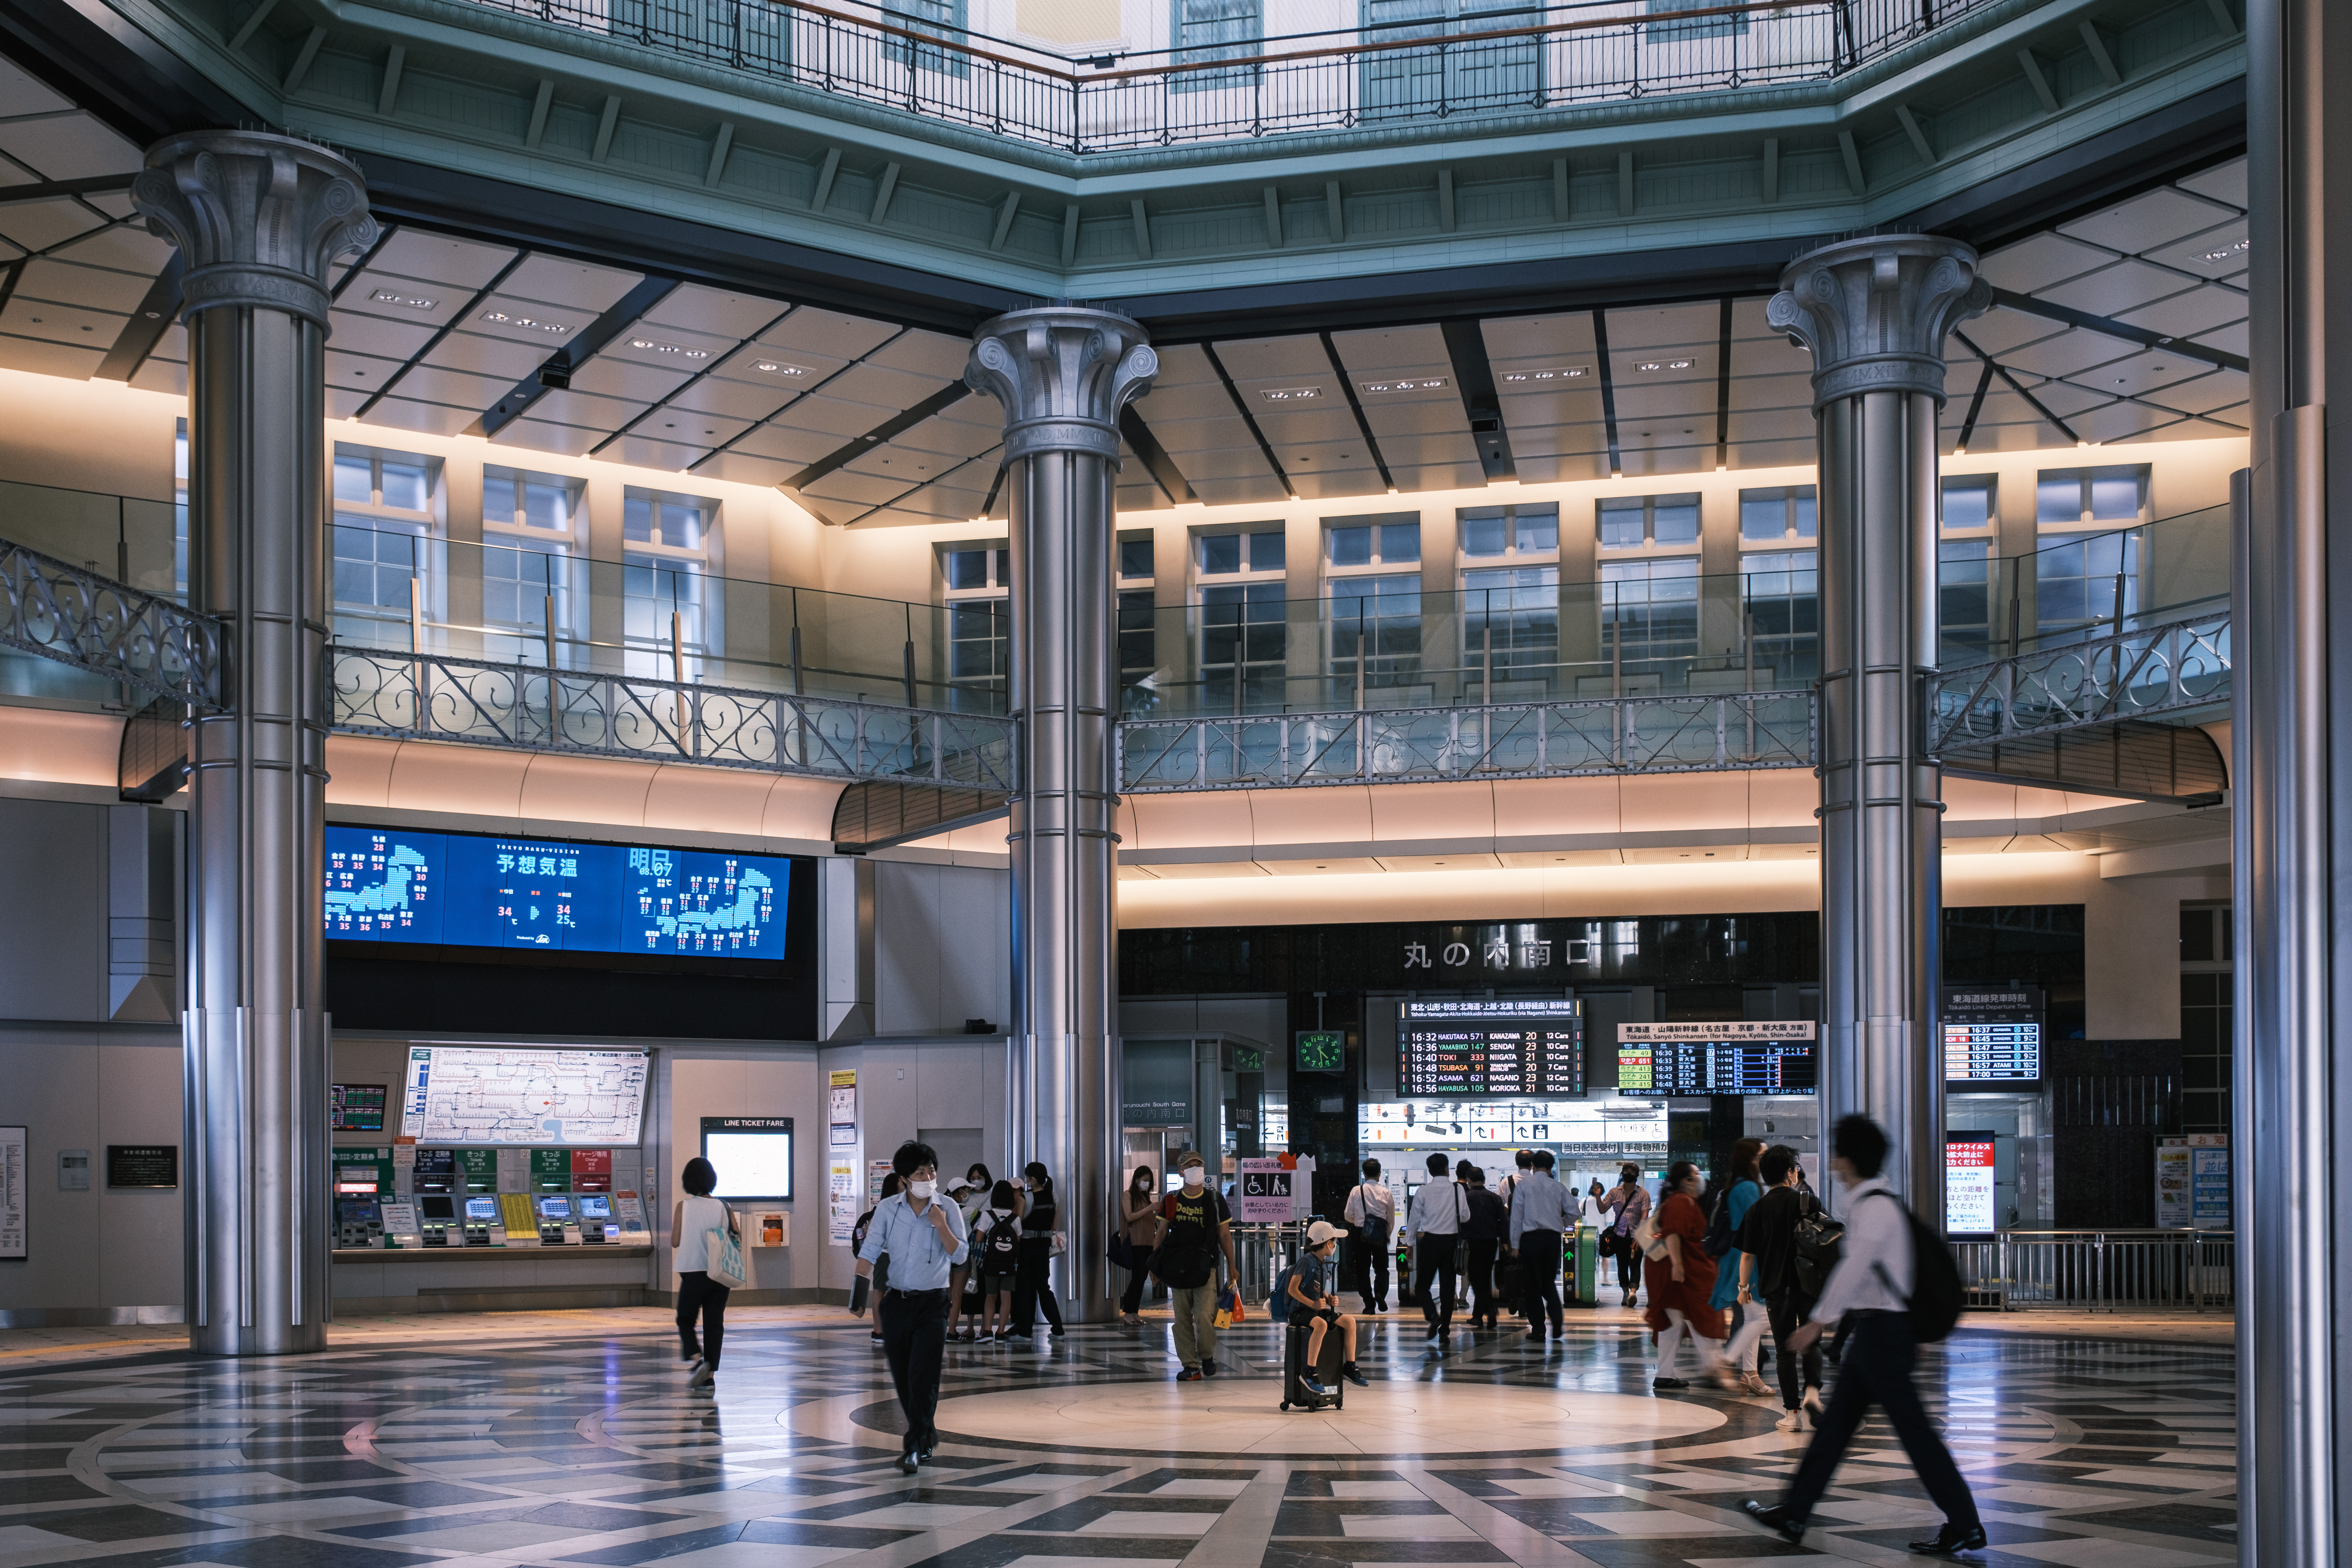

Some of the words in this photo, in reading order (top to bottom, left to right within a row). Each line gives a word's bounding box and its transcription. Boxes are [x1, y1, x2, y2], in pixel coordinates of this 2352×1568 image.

[497, 854, 577, 877] 予想気温
[498, 906, 512, 916] 34
[557, 905, 570, 914] 34
[556, 914, 570, 924] 25
[1404, 938, 1591, 968] 丸の内南口
[1953, 994, 2026, 1003] 東海道線発車時刻
[1412, 1033, 1436, 1041] 16:32
[1412, 1043, 1436, 1052] 16:36
[1412, 1084, 1436, 1093] 16:56
[1564, 1143, 1616, 1152] 当日配送受付
